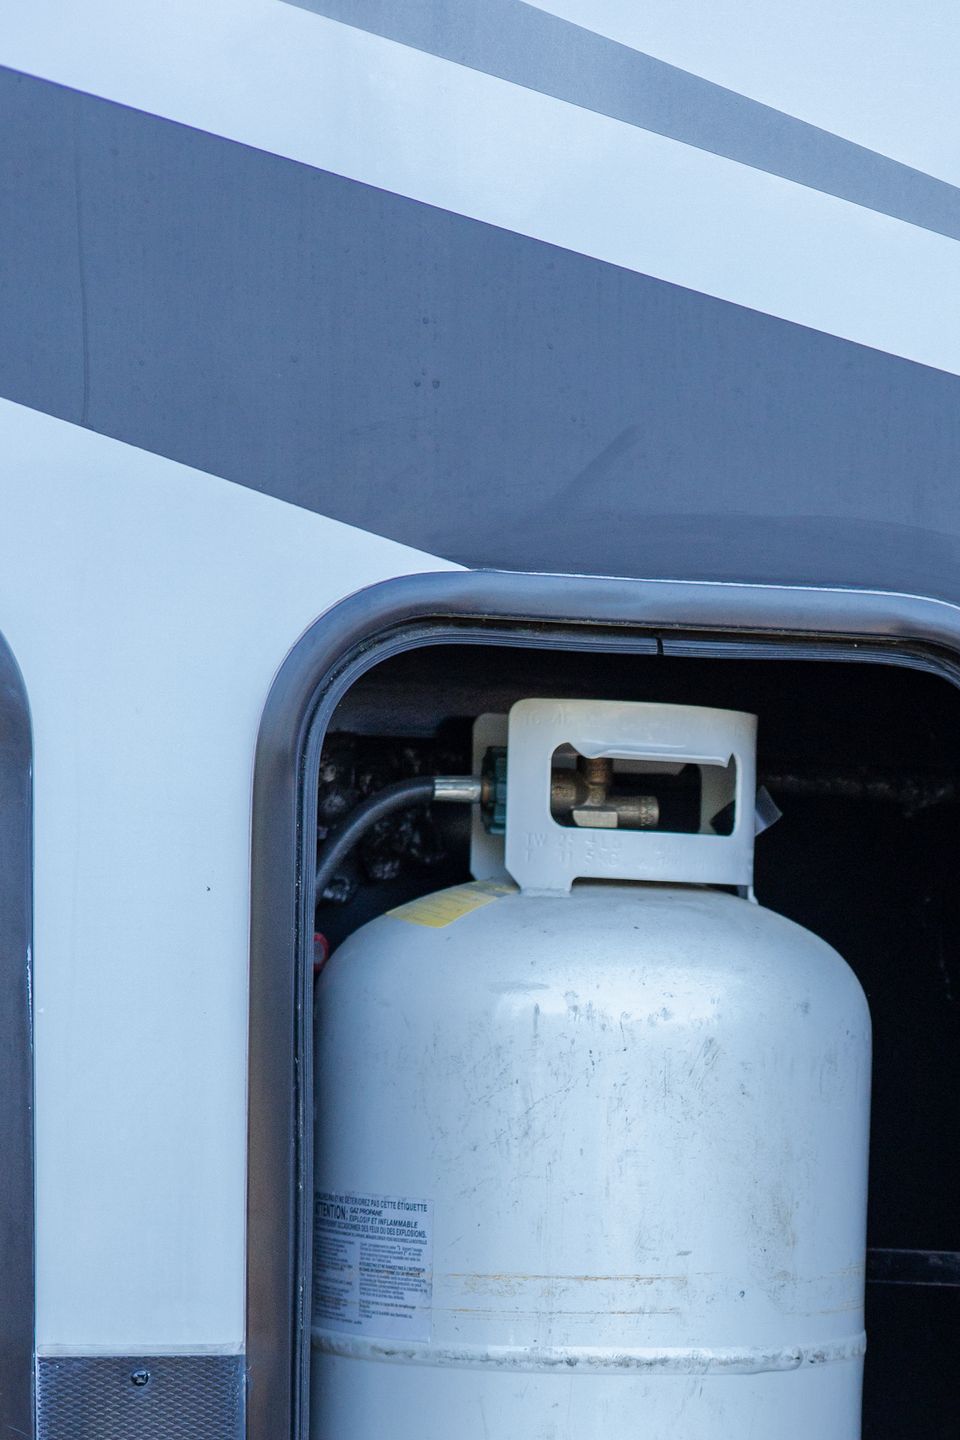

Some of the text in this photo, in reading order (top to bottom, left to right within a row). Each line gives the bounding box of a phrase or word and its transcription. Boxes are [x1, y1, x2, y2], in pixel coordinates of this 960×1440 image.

[381, 1200, 396, 1209] CETTE
[398, 1200, 427, 1212] ÉTIQUETTE
[359, 1208, 383, 1216] PROPANE
[349, 1215, 370, 1223] EXPLOSIF
[378, 1218, 418, 1228] INFLAMMABLE
[396, 1228, 427, 1238] EXPLOSIONS.
